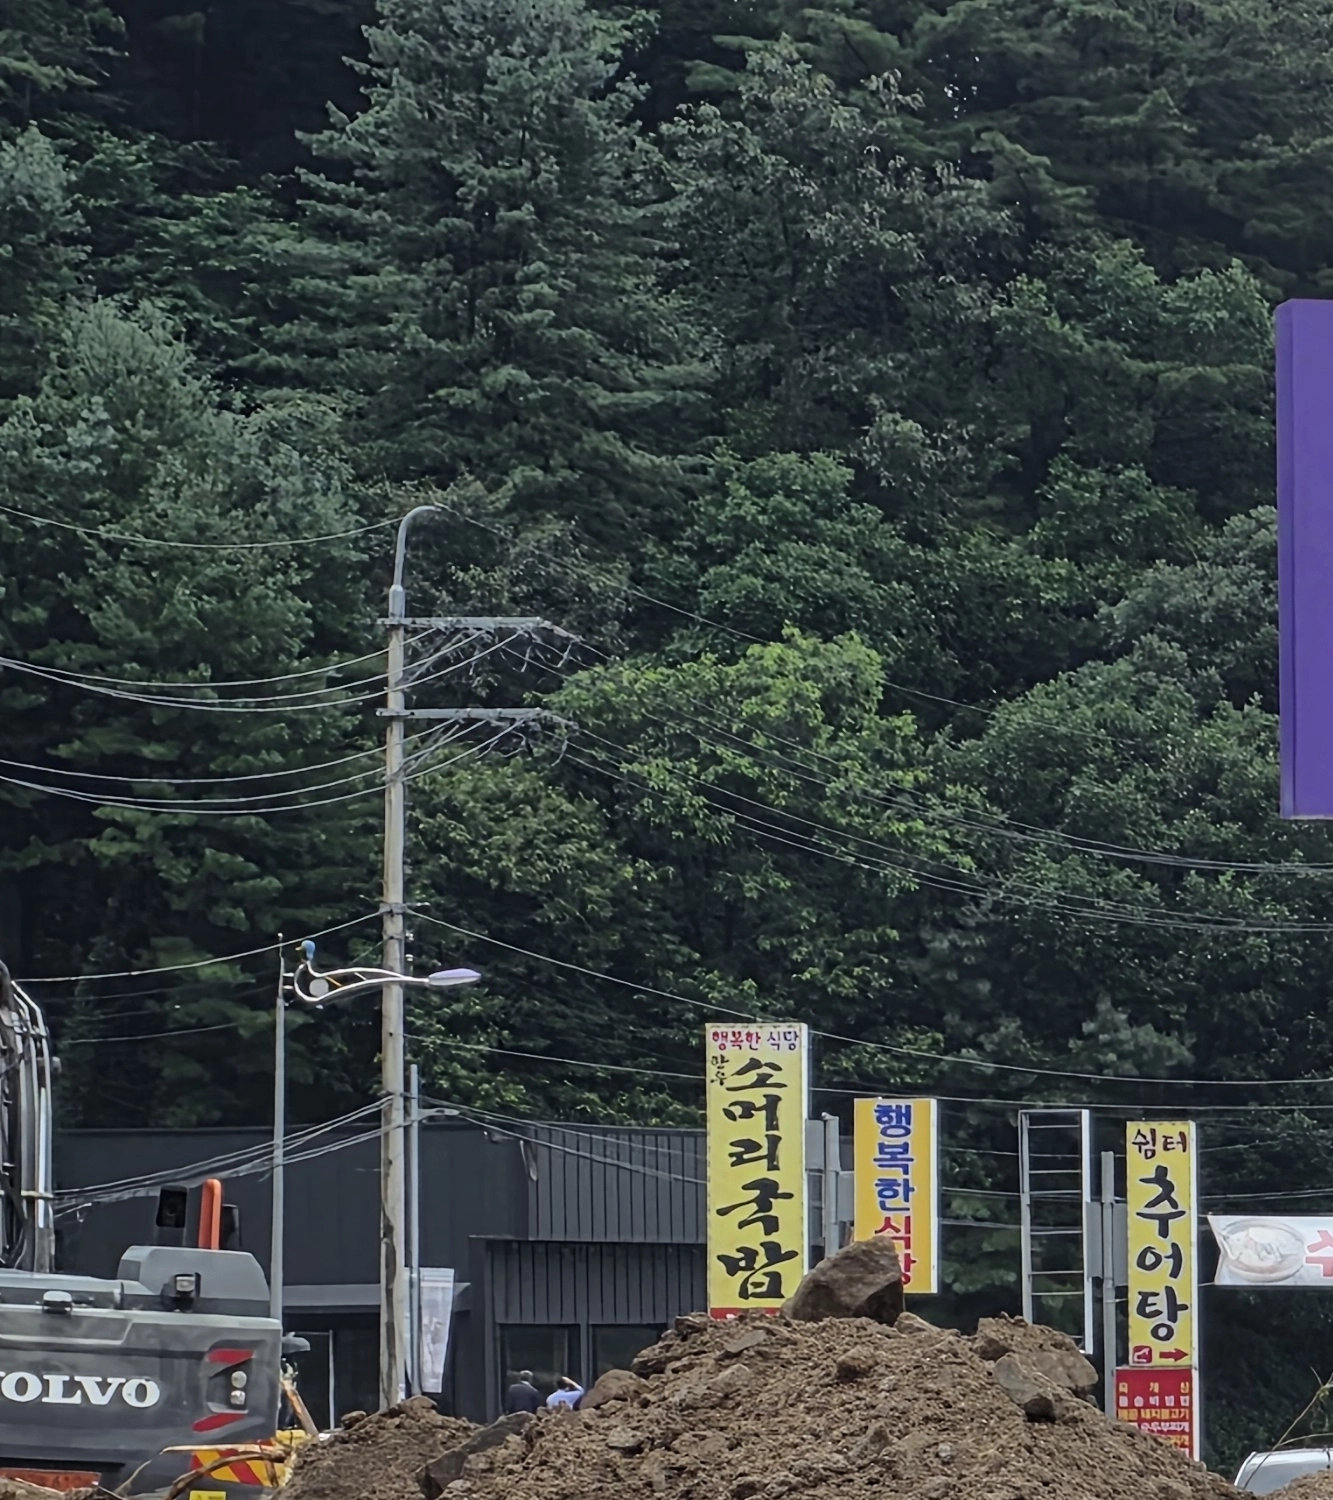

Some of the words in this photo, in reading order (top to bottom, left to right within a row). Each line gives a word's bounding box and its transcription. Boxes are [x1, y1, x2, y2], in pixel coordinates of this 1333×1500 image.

[712, 1031, 761, 1051] 행복한
[767, 1031, 799, 1051] 식당
[716, 1057, 799, 1300] 소머리국밥
[874, 1104, 915, 1212] 행복한
[1131, 1128, 1187, 1160] 쉼터
[1136, 1165, 1189, 1341] 추어탕
[0, 1371, 160, 1408] OLVO
